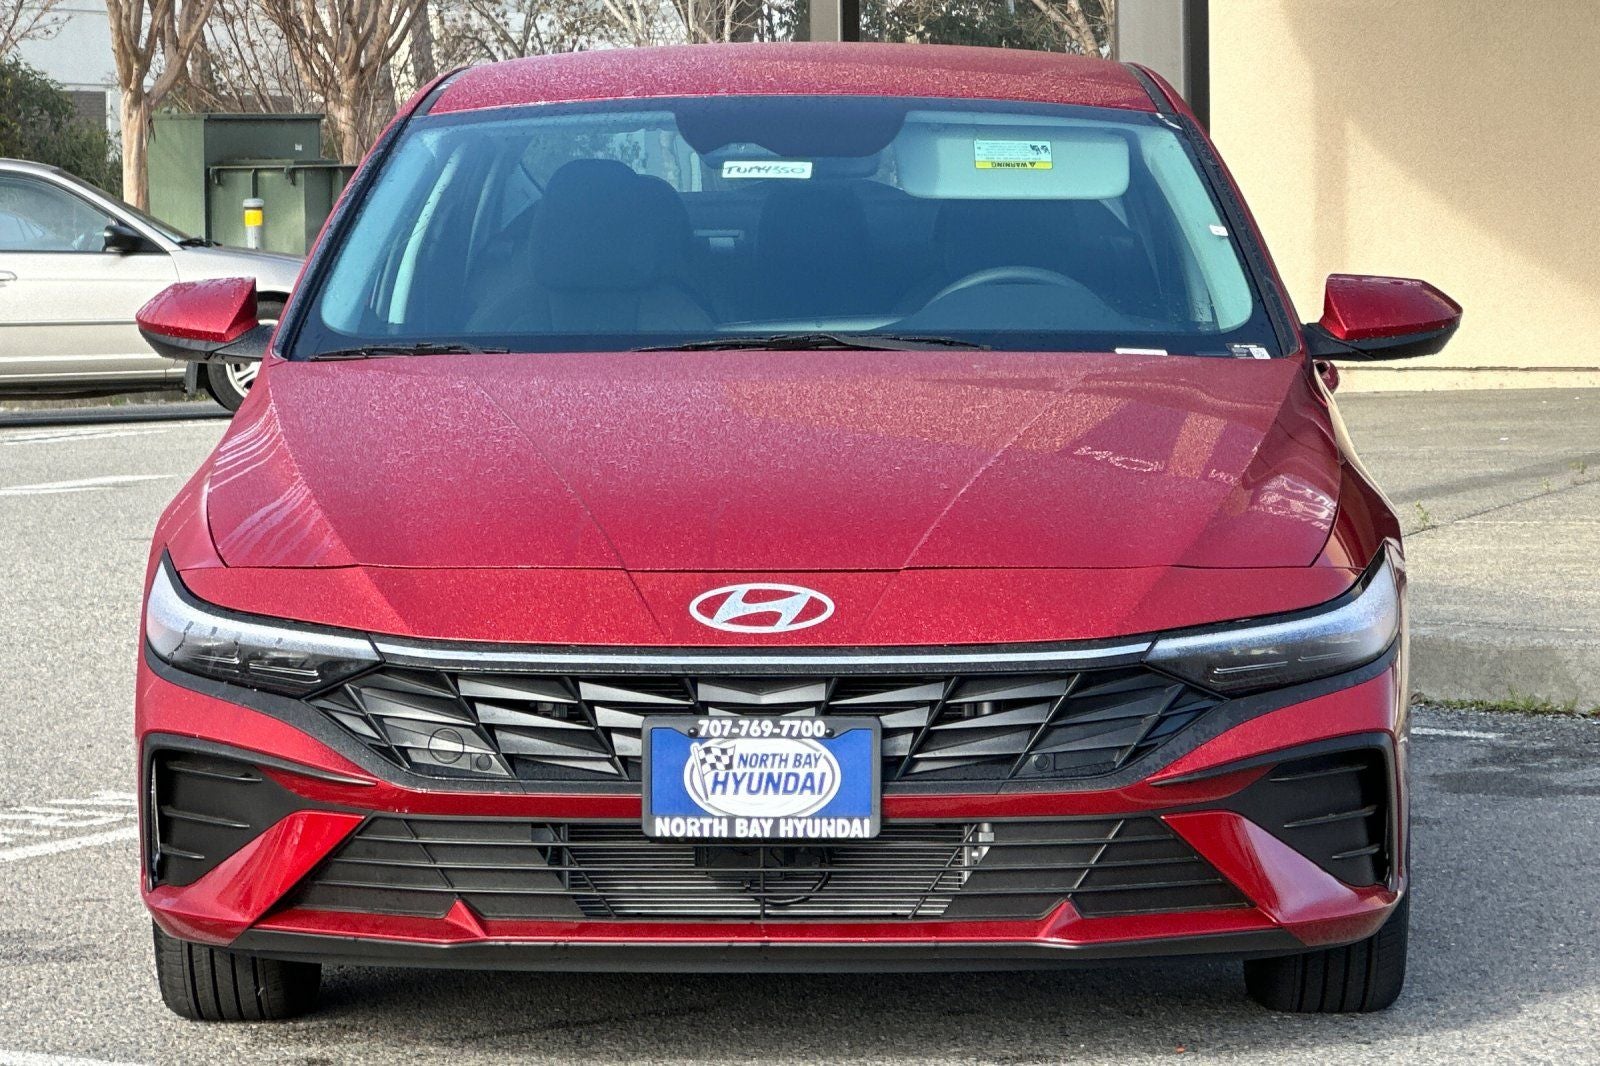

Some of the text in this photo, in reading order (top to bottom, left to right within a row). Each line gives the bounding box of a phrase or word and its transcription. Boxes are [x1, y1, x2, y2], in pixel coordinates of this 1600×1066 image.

[698, 719, 825, 737] 707-769-7700
[737, 752, 823, 769] NORTH BAY
[710, 771, 826, 796] HYUNDAI
[655, 817, 871, 838] NORTH BAY HYUNDAI
